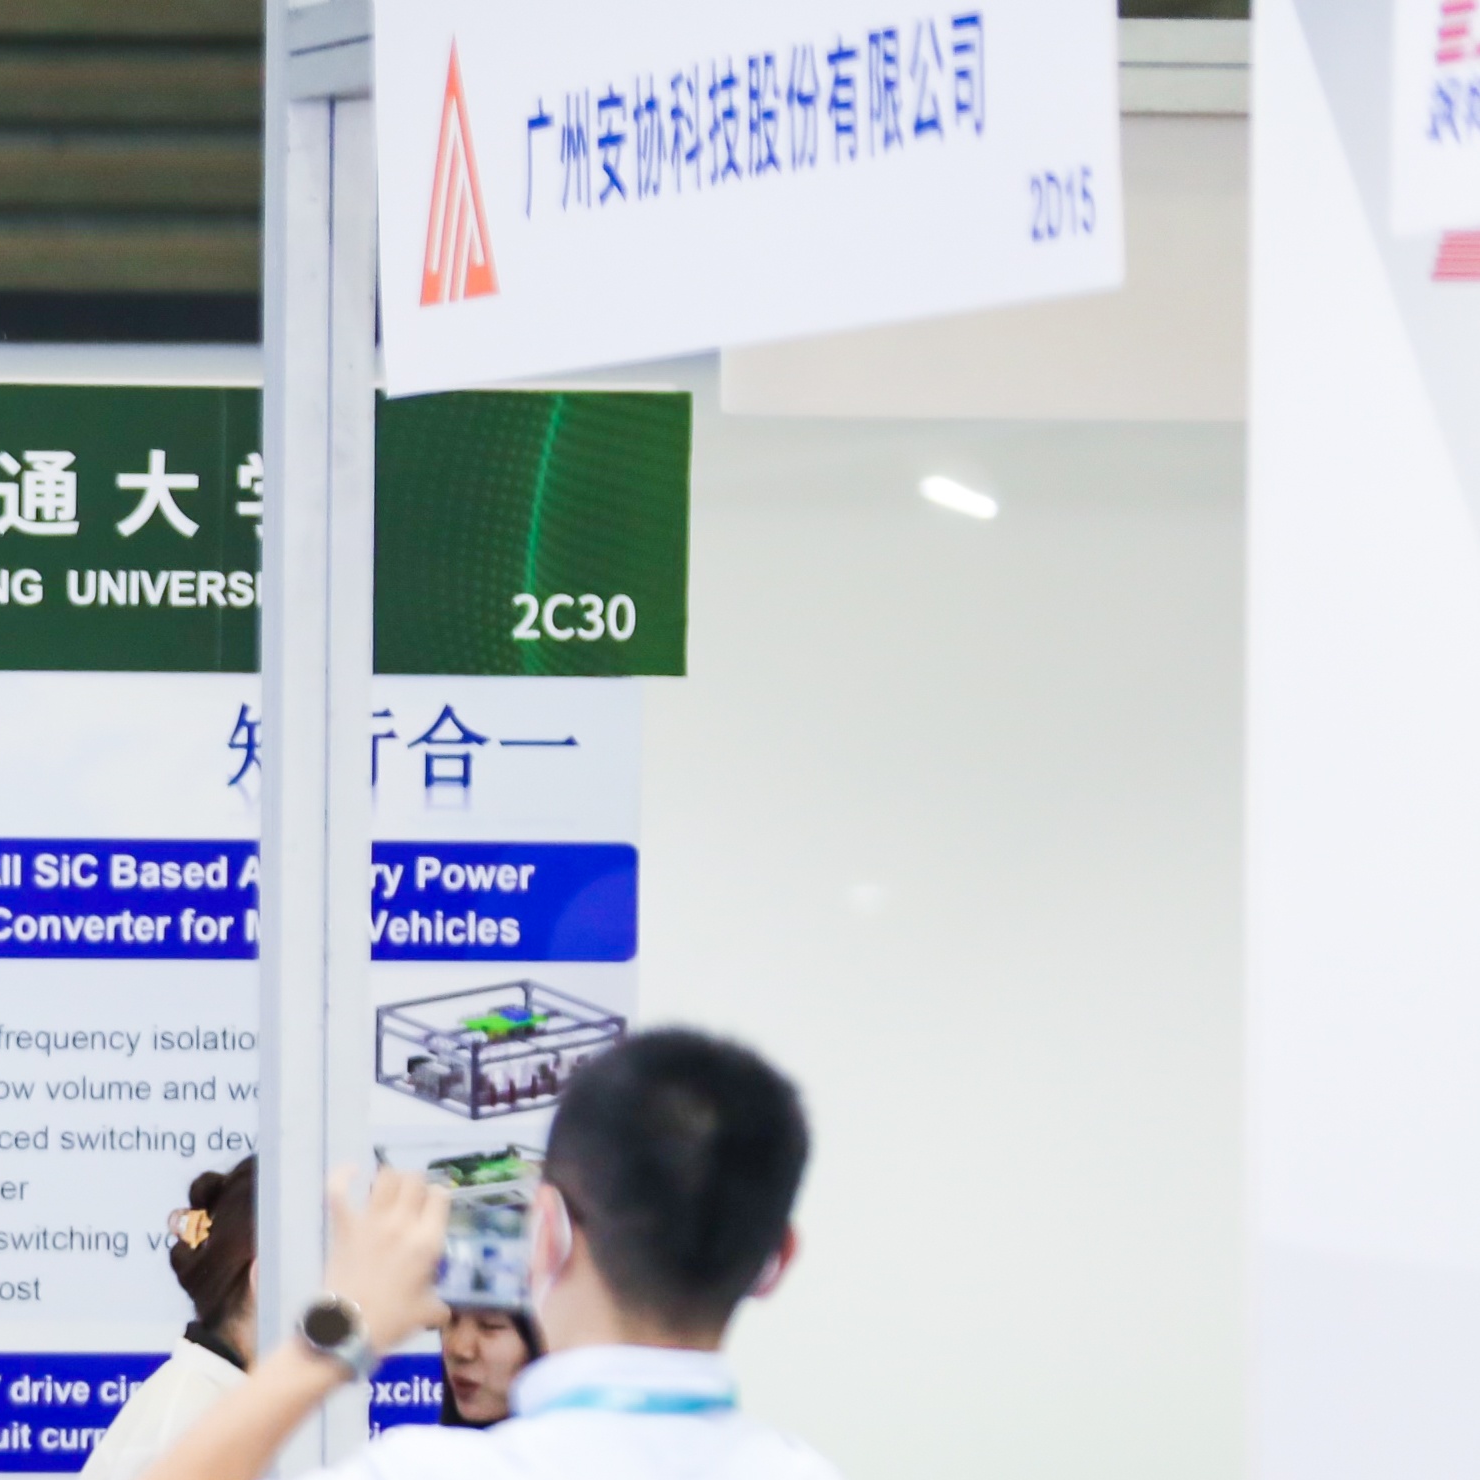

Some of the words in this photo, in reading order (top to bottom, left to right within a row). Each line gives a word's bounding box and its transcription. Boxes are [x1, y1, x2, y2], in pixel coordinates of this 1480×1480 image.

[523, 9, 987, 221] 广州安协科技股份有限公司
[1028, 166, 1097, 245] 2D15
[512, 593, 638, 643] 2C30
[32, 854, 99, 890] SiC
[108, 854, 229, 890] Based
[416, 857, 537, 893] Power
[180, 908, 236, 944] for
[47, 1076, 154, 1103] volume
[162, 1075, 219, 1102] and
[61, 1126, 198, 1160] switching
[7, 1374, 91, 1406] drive
